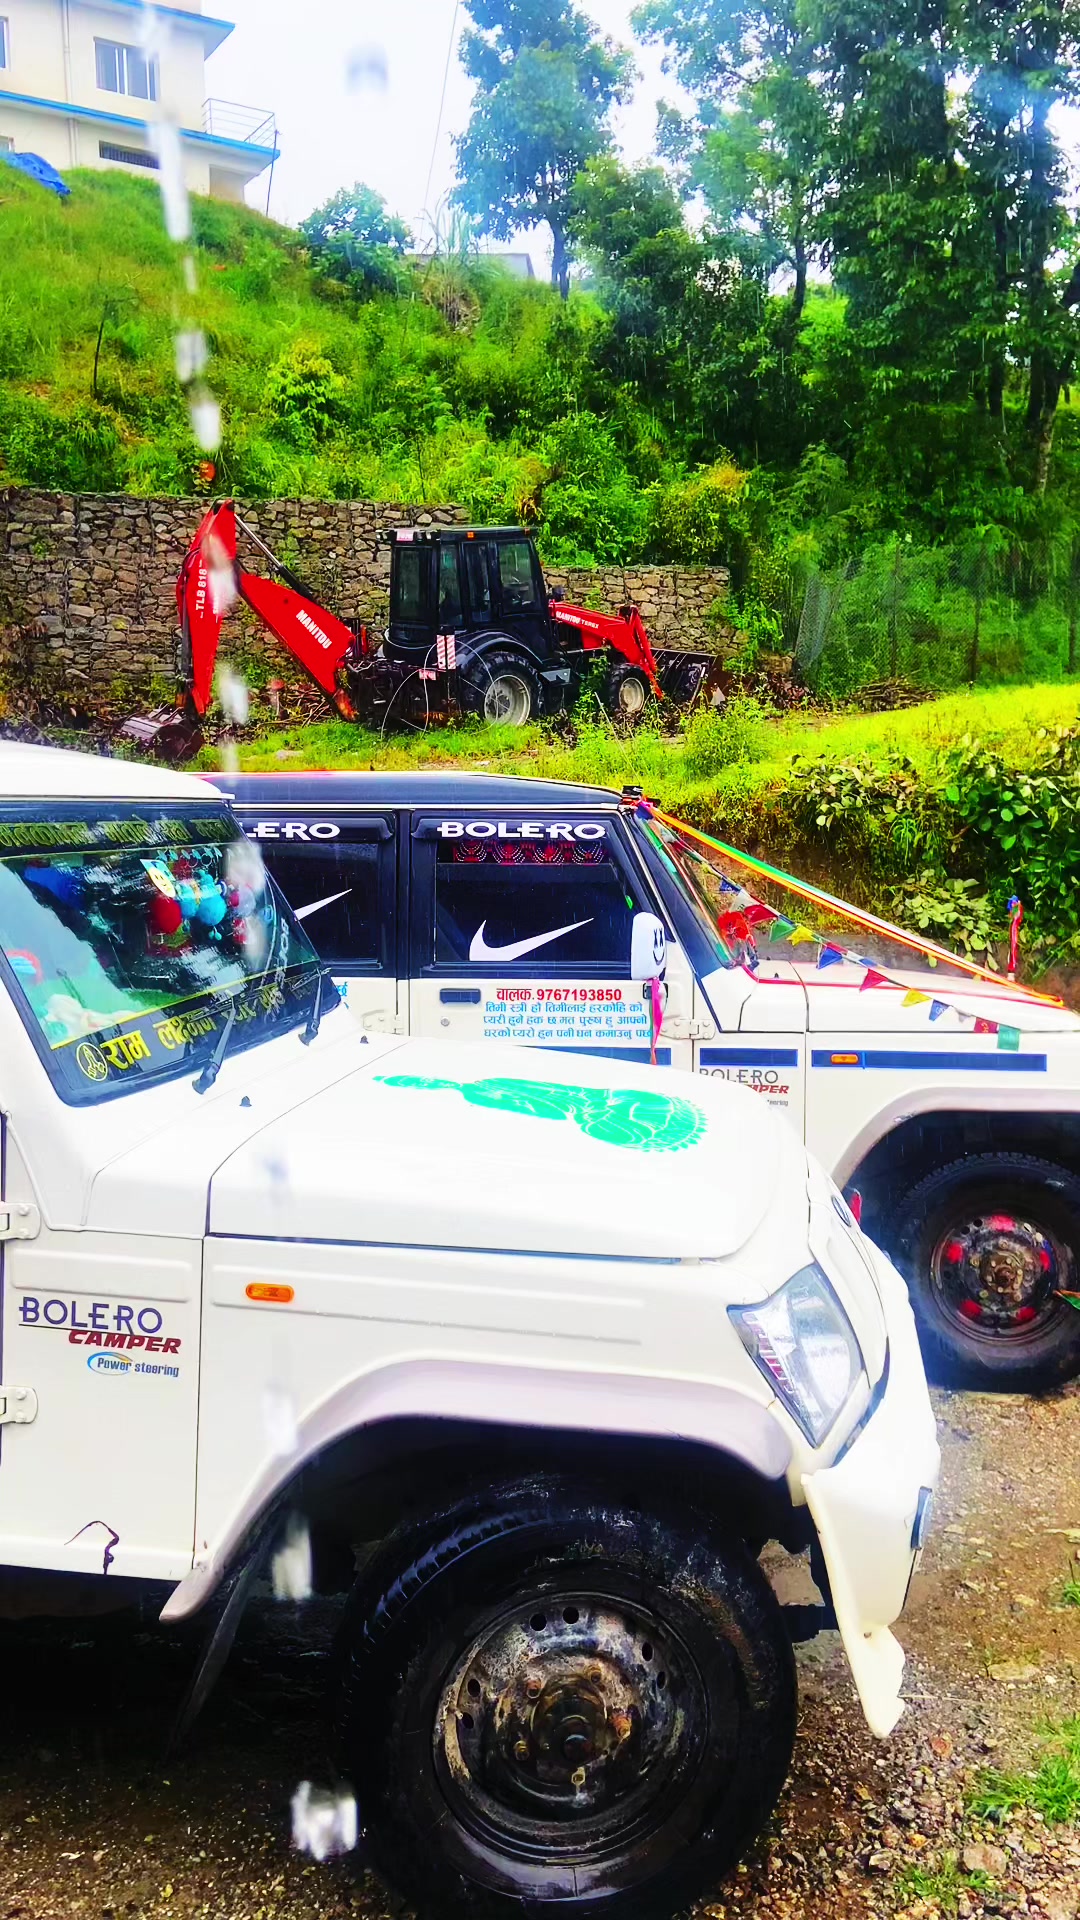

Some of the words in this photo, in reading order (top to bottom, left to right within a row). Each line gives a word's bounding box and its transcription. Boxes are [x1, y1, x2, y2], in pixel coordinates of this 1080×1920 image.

[197, 567, 208, 588] 818
[195, 588, 207, 611] TLB
[295, 609, 333, 650] MANITOU
[437, 821, 606, 842] BOLERO
[536, 988, 622, 1001] 9767193850
[100, 1029, 152, 1070] राम
[19, 1296, 163, 1335] BOLERO
[68, 1329, 182, 1354] CAMPER
[97, 1357, 132, 1371] Power
[134, 1362, 180, 1378] steering
